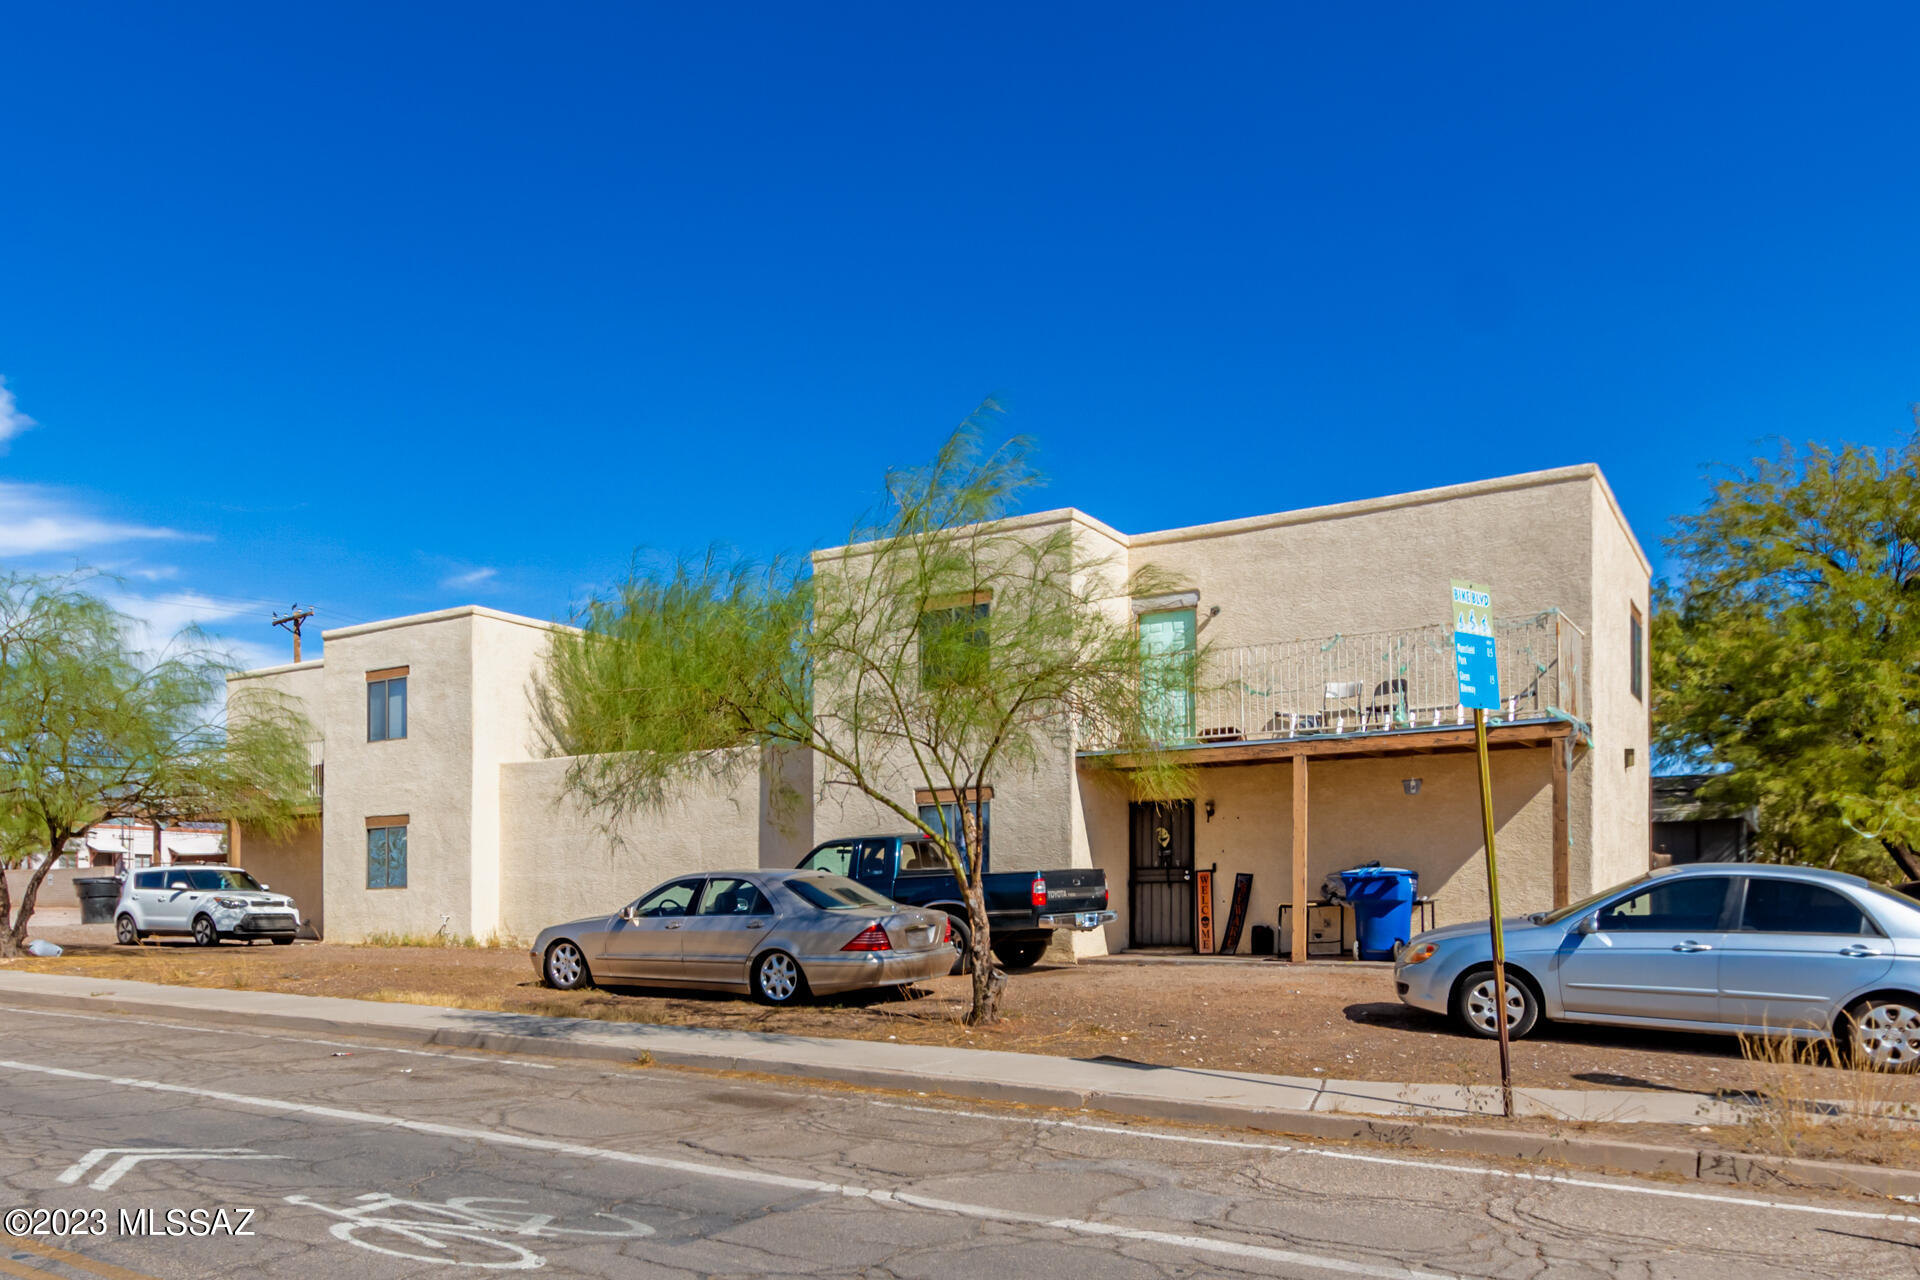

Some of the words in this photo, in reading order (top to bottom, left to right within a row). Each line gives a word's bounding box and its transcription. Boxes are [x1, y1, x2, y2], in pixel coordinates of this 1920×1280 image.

[1453, 588, 1470, 602] BIKE
[1472, 590, 1490, 607] BLVD
[1199, 875, 1210, 950] WELCOME
